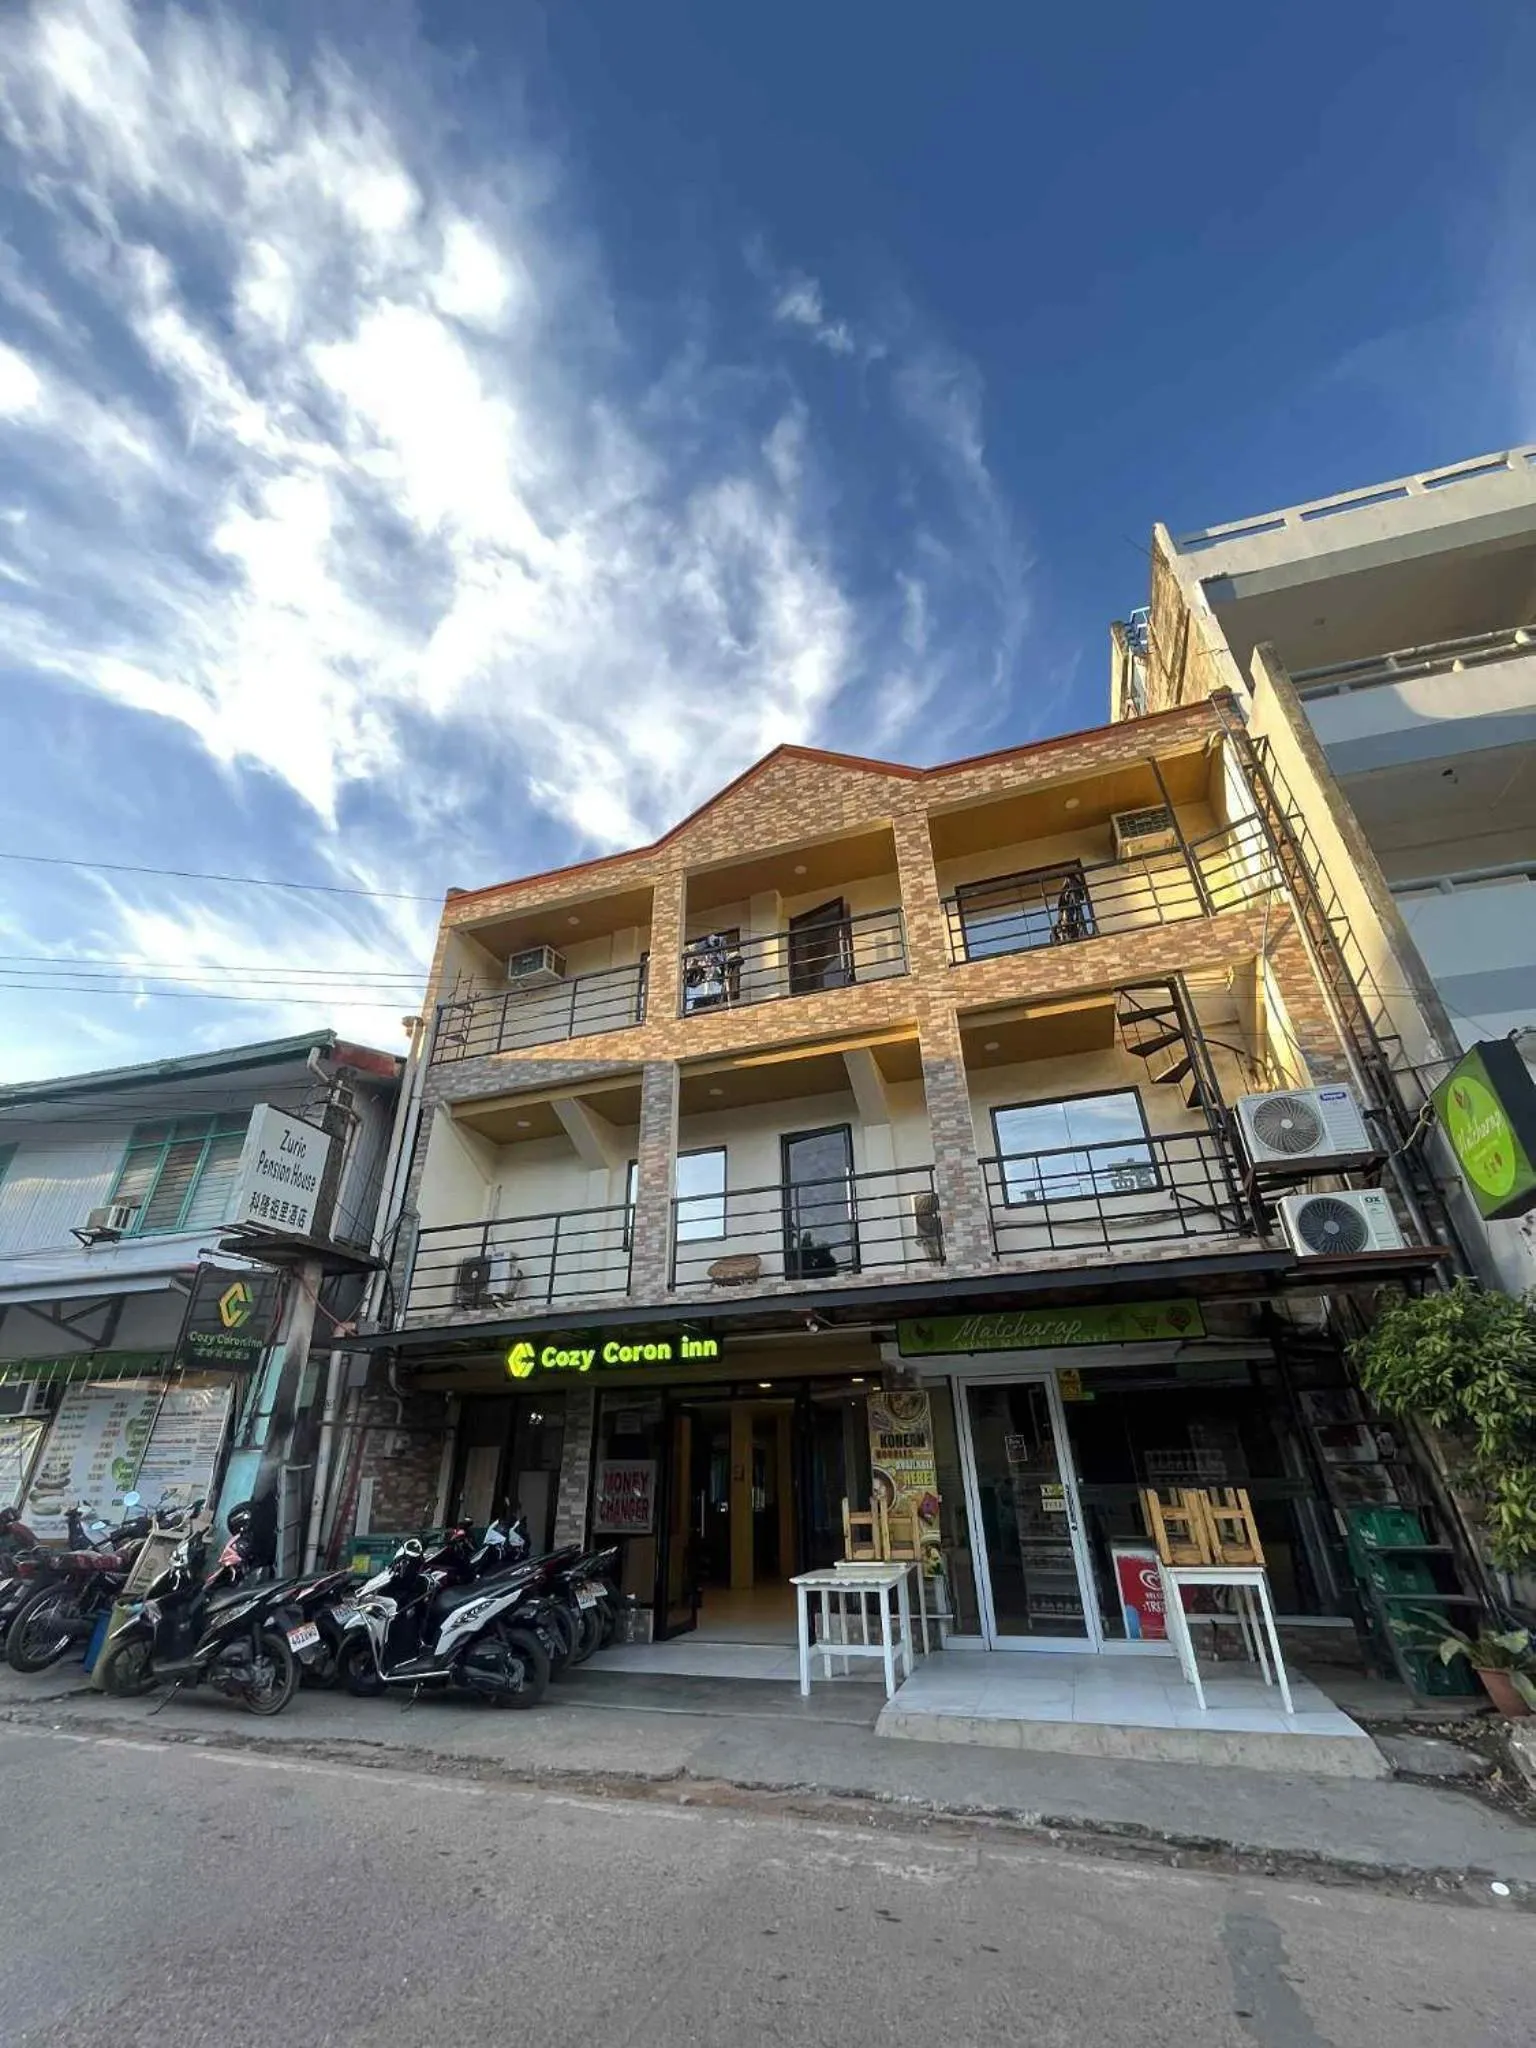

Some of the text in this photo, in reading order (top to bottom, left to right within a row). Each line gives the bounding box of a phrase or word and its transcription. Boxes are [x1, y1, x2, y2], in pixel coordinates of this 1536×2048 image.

[280, 1129, 307, 1159] Zuric
[256, 1149, 316, 1193] Pension House
[189, 1330, 216, 1346] Cozy
[952, 1311, 1082, 1344] Matcharap
[541, 1335, 718, 1371] Cozy Coron inn
[603, 1470, 650, 1493] MONEY
[600, 1496, 649, 1522] CHANGER
